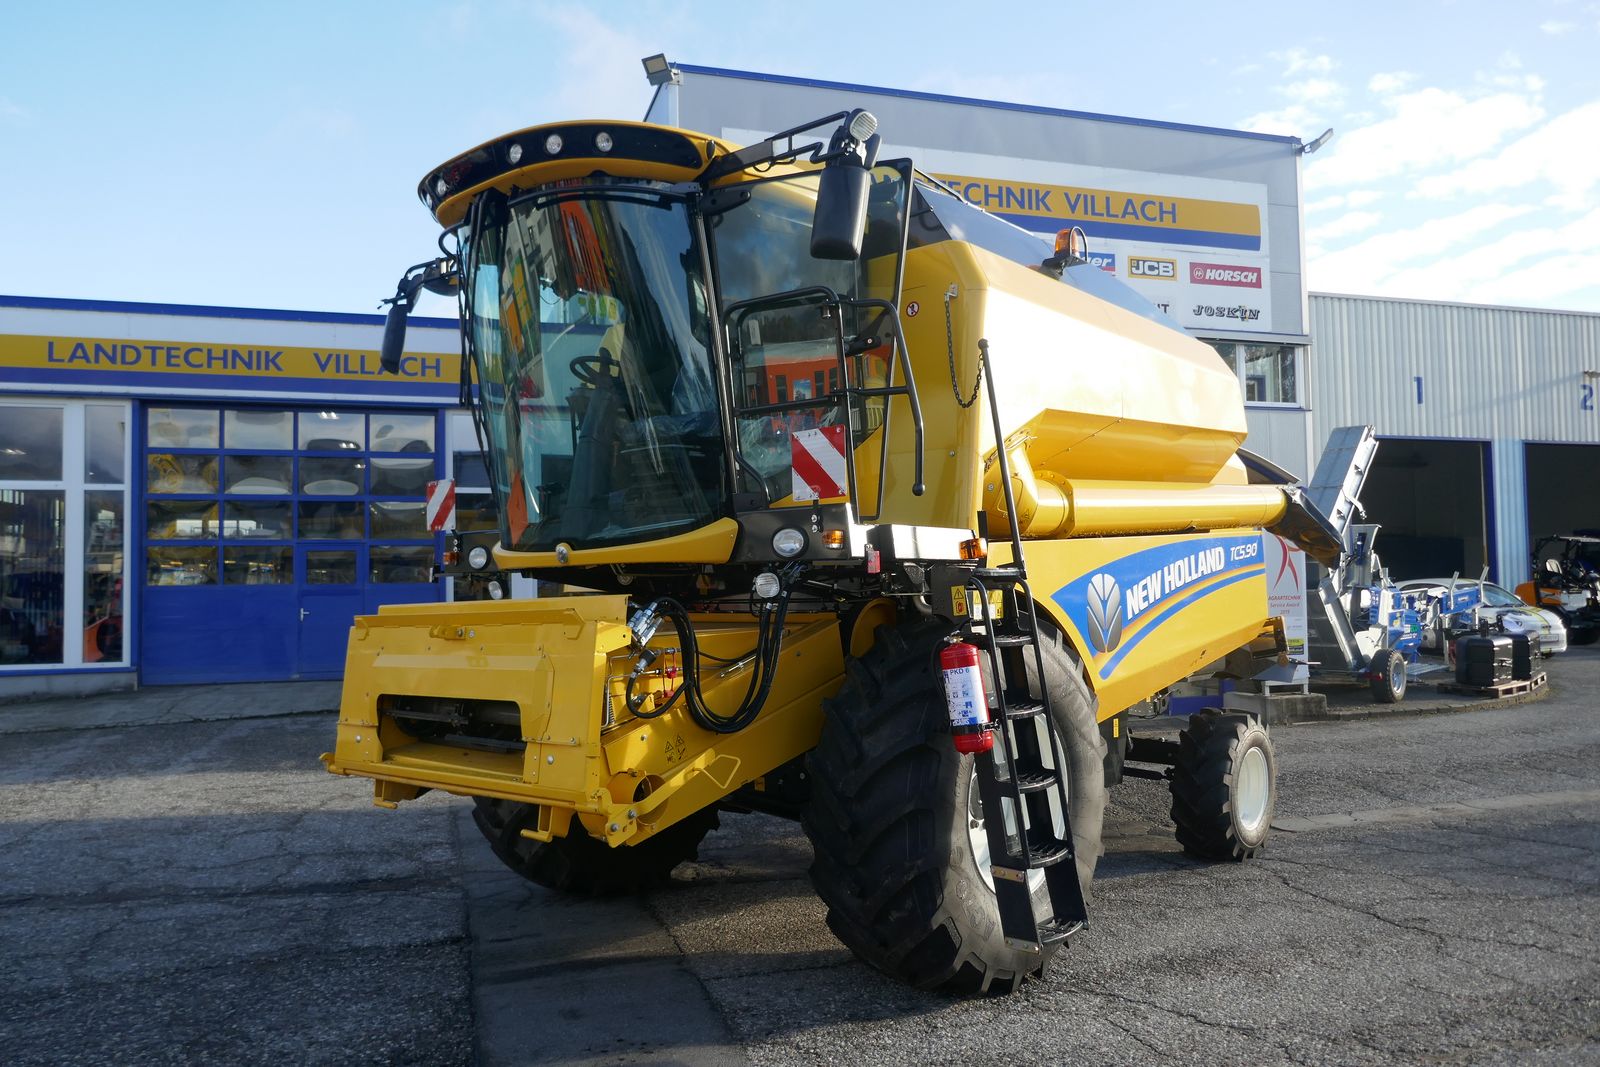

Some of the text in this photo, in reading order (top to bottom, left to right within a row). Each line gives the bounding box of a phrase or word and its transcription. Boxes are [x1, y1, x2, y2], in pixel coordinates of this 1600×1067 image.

[1063, 191, 1177, 224] VILLACH
[1131, 260, 1174, 277] JCB
[1205, 268, 1258, 283] HORSCH
[1193, 304, 1261, 320] JOSKIN
[47, 341, 285, 372] LANDTECHNIK
[1413, 376, 1424, 405] 1
[1580, 384, 1594, 411] 2
[1125, 569, 1162, 620] NEW
[1163, 546, 1225, 595] HOLLAND
